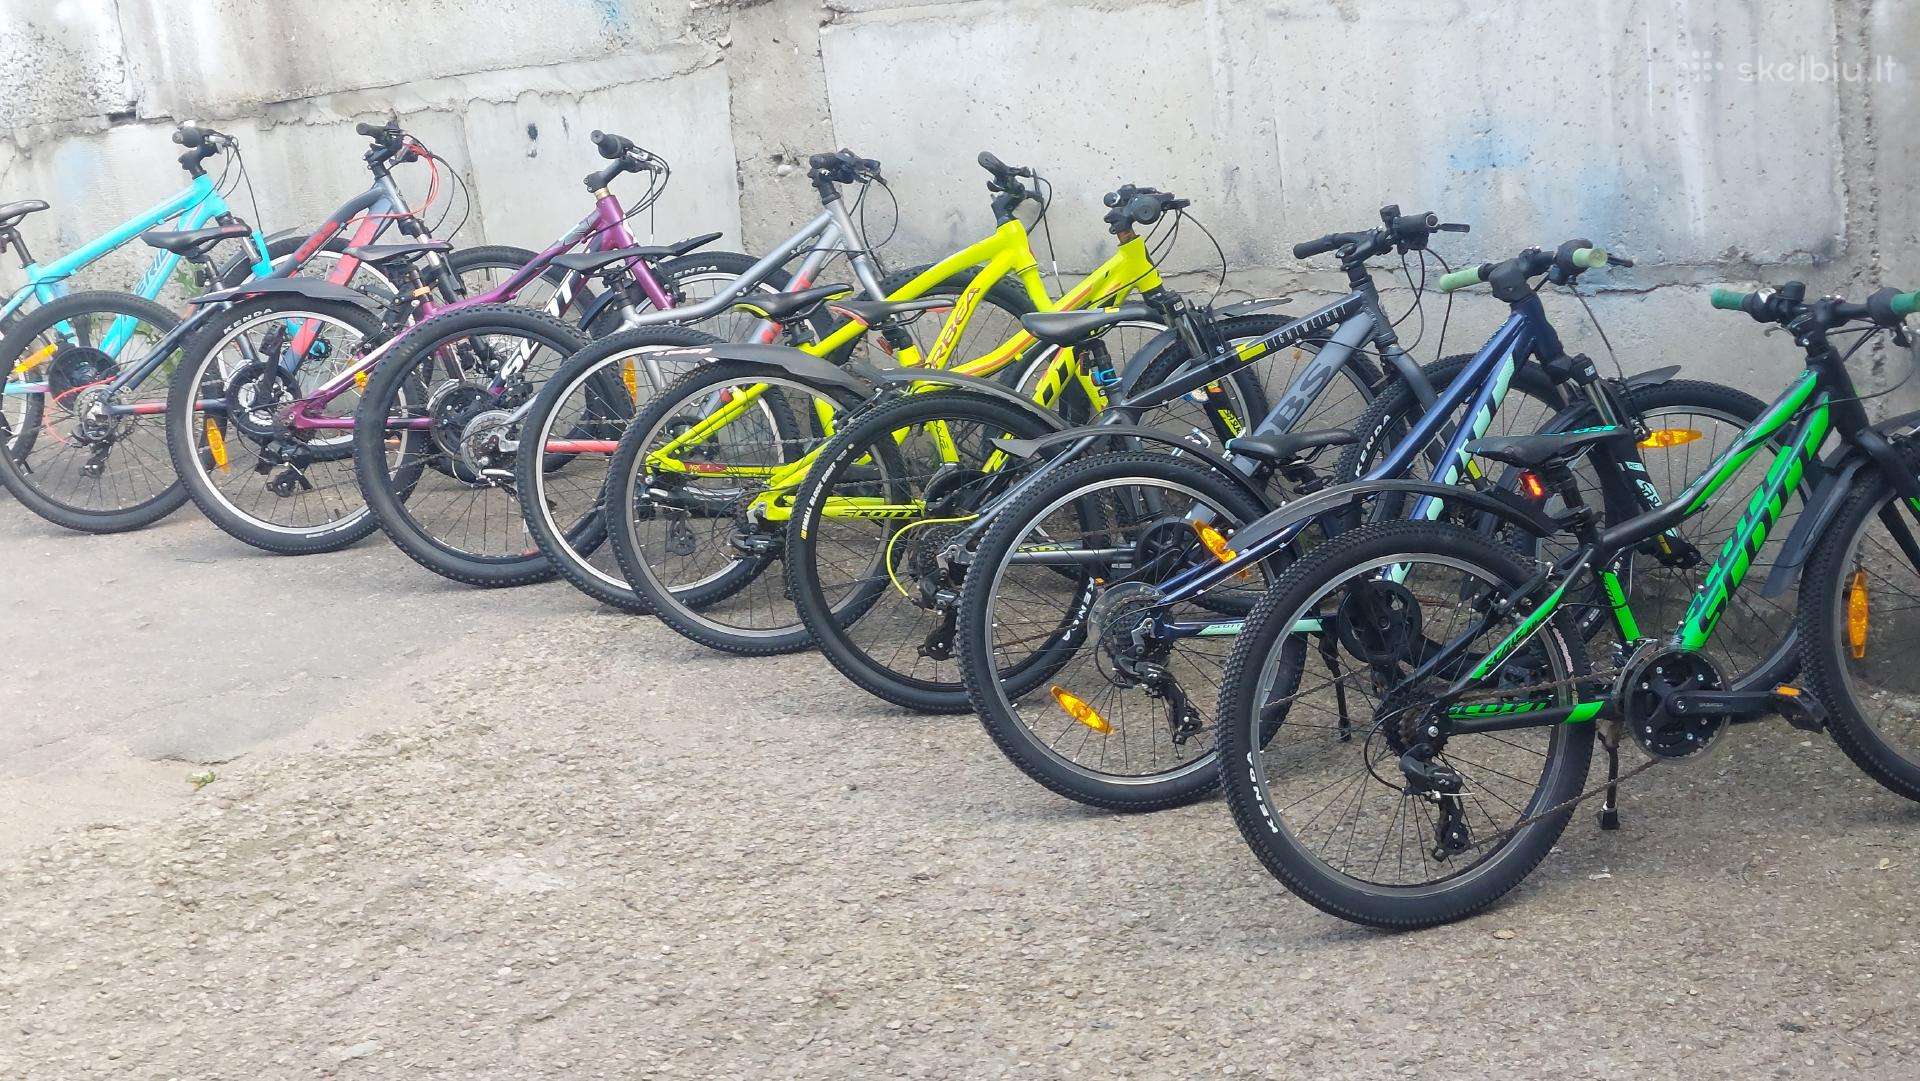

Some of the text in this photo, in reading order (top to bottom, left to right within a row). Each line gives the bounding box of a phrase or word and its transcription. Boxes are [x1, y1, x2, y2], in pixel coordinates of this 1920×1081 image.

[672, 265, 718, 278] ENDA
[223, 308, 272, 335] KENDA
[501, 269, 575, 380] SCTT
[928, 288, 981, 368] RBEA
[1265, 304, 1347, 350] LIGHTWEIGHT
[1355, 414, 1391, 478] KENDA
[1697, 430, 1812, 634] SCOTT
[1062, 576, 1095, 641] KENDA
[1246, 751, 1279, 834] KENDA
